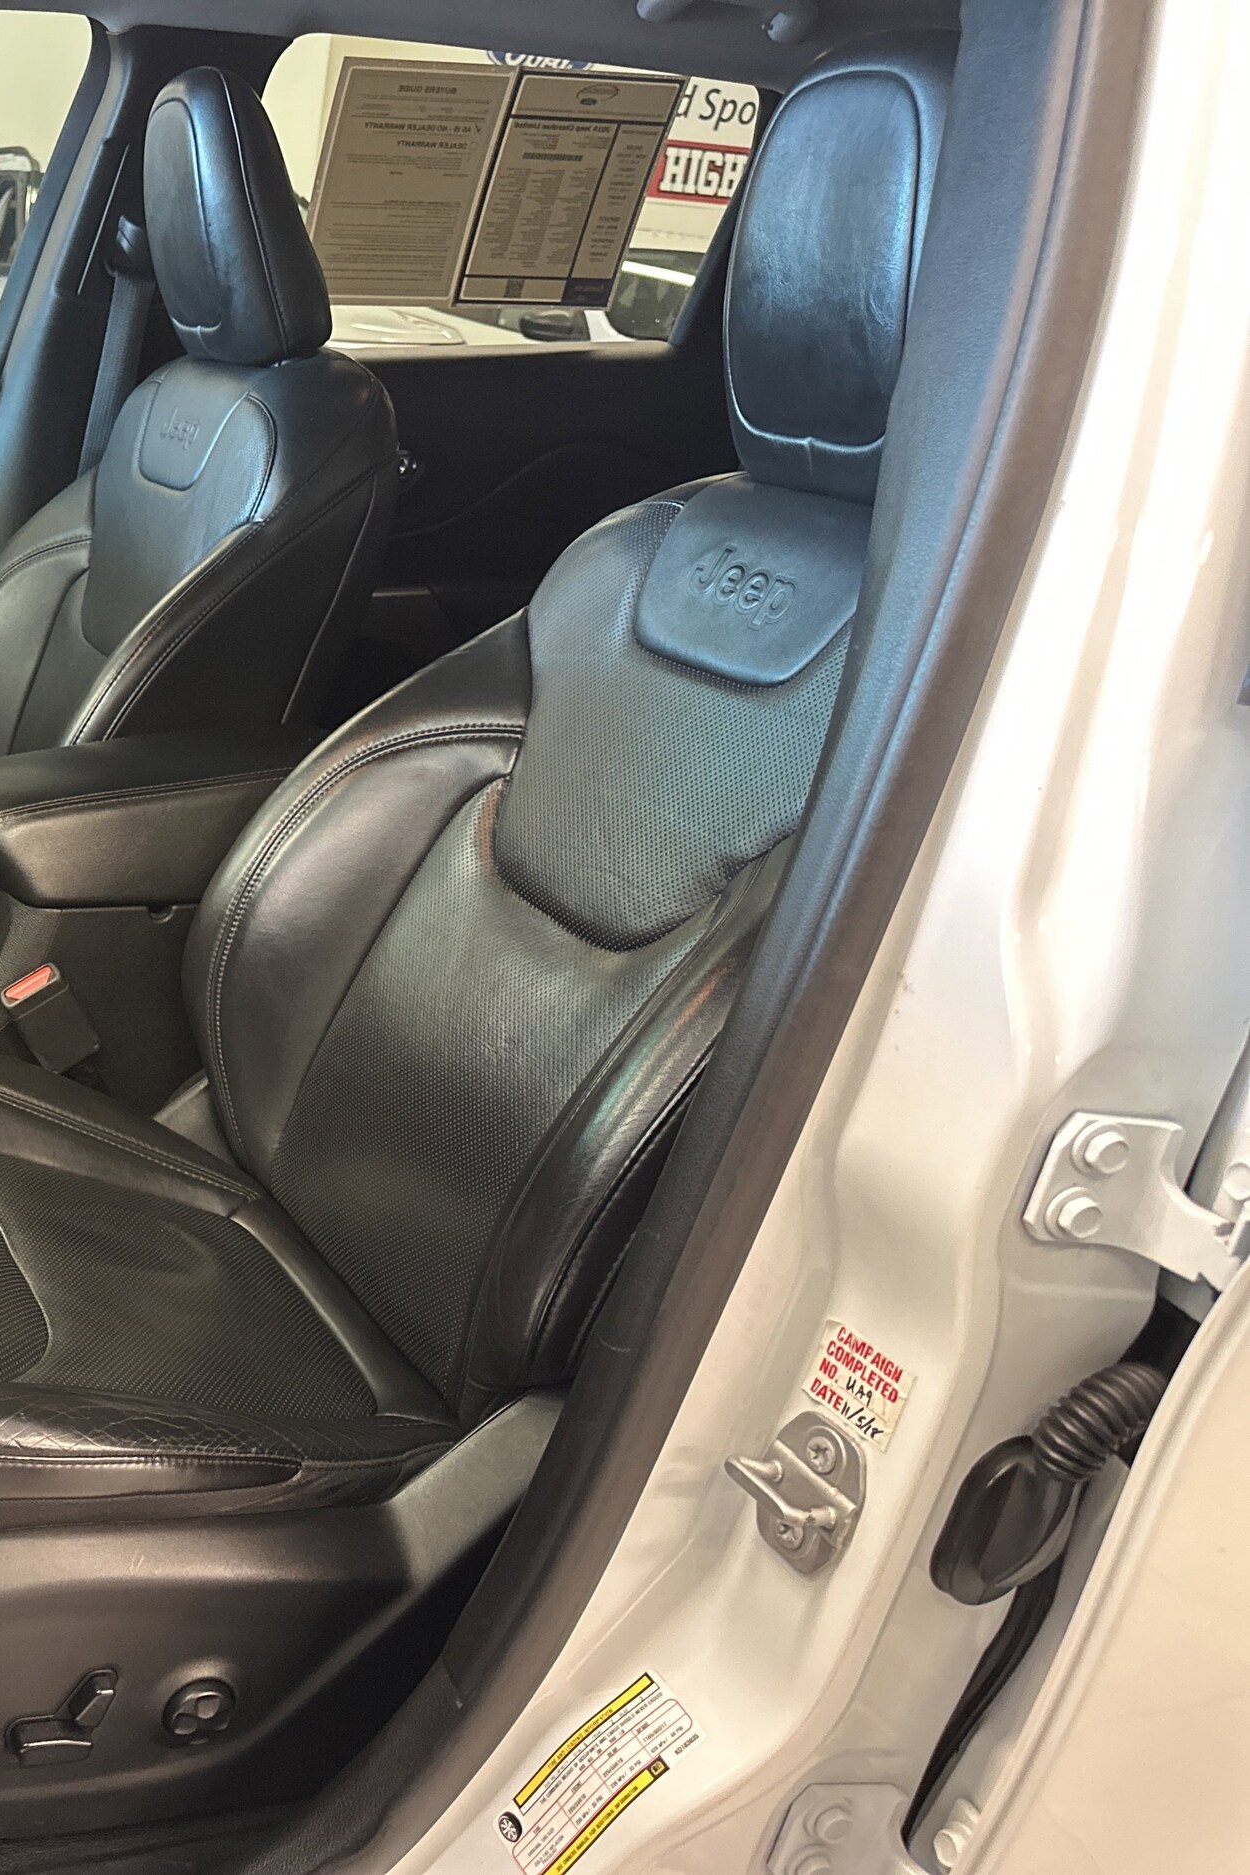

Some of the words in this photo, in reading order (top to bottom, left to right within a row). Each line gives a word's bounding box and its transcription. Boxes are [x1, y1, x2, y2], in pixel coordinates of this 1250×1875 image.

[659, 147, 749, 198] HIGH
[159, 406, 200, 450] Jeep
[688, 543, 797, 631] Jeep
[819, 1357, 838, 1384] NO.
[827, 1340, 899, 1404] COMPLETED
[837, 1326, 903, 1383] CAMPAIGN
[810, 1377, 844, 1411] DATE
